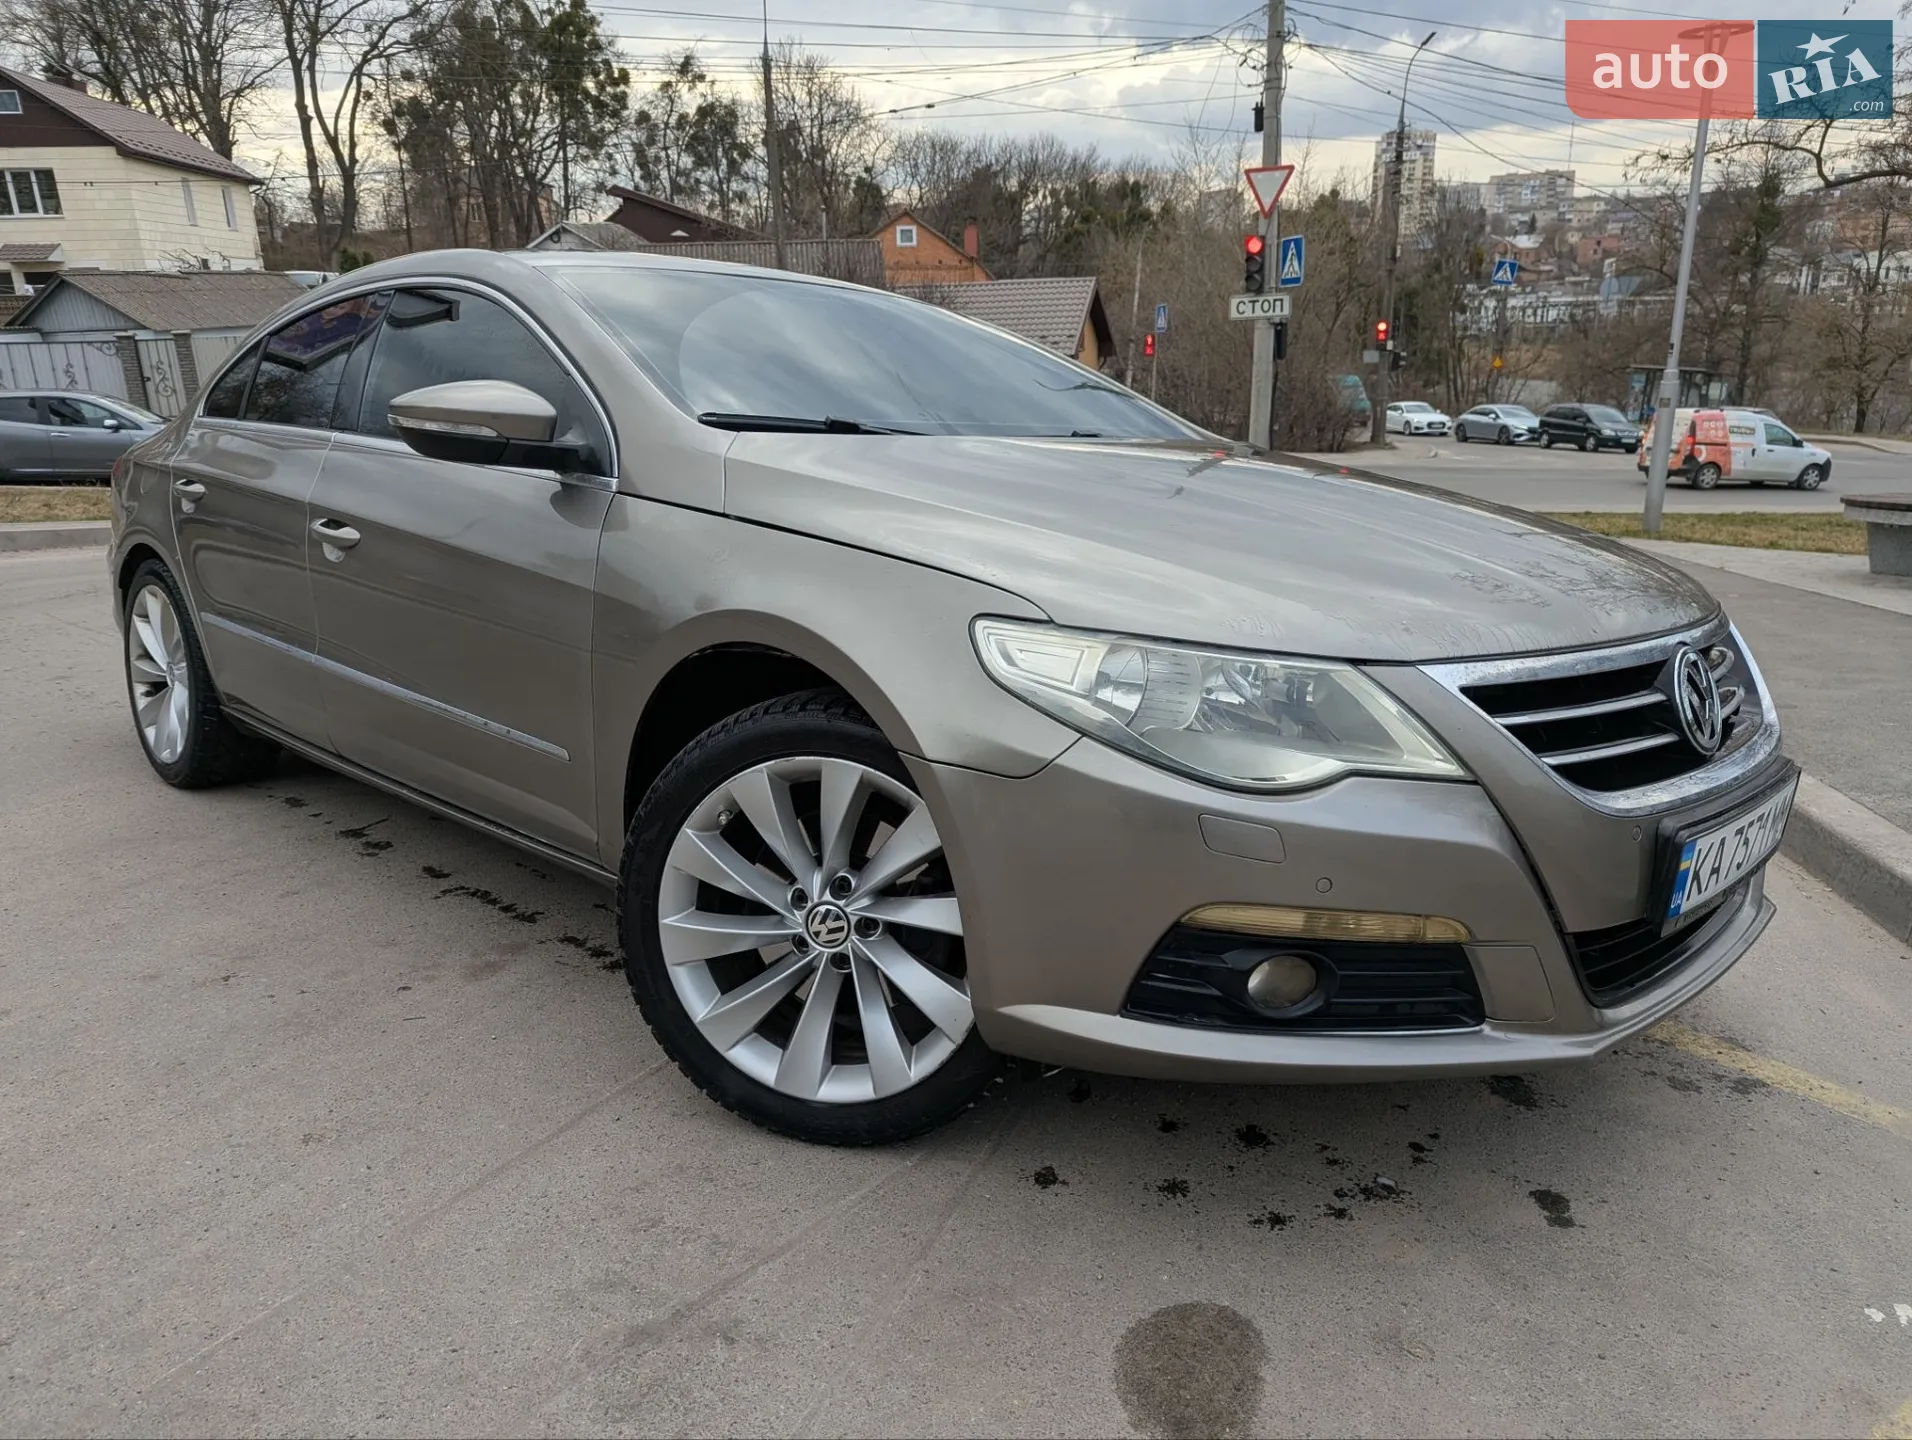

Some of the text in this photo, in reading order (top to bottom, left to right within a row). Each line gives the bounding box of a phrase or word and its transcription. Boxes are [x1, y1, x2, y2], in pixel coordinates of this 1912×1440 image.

[1236, 298, 1284, 315] СТОП
[1686, 836, 1727, 902] KA
[1670, 891, 1683, 909] UA
